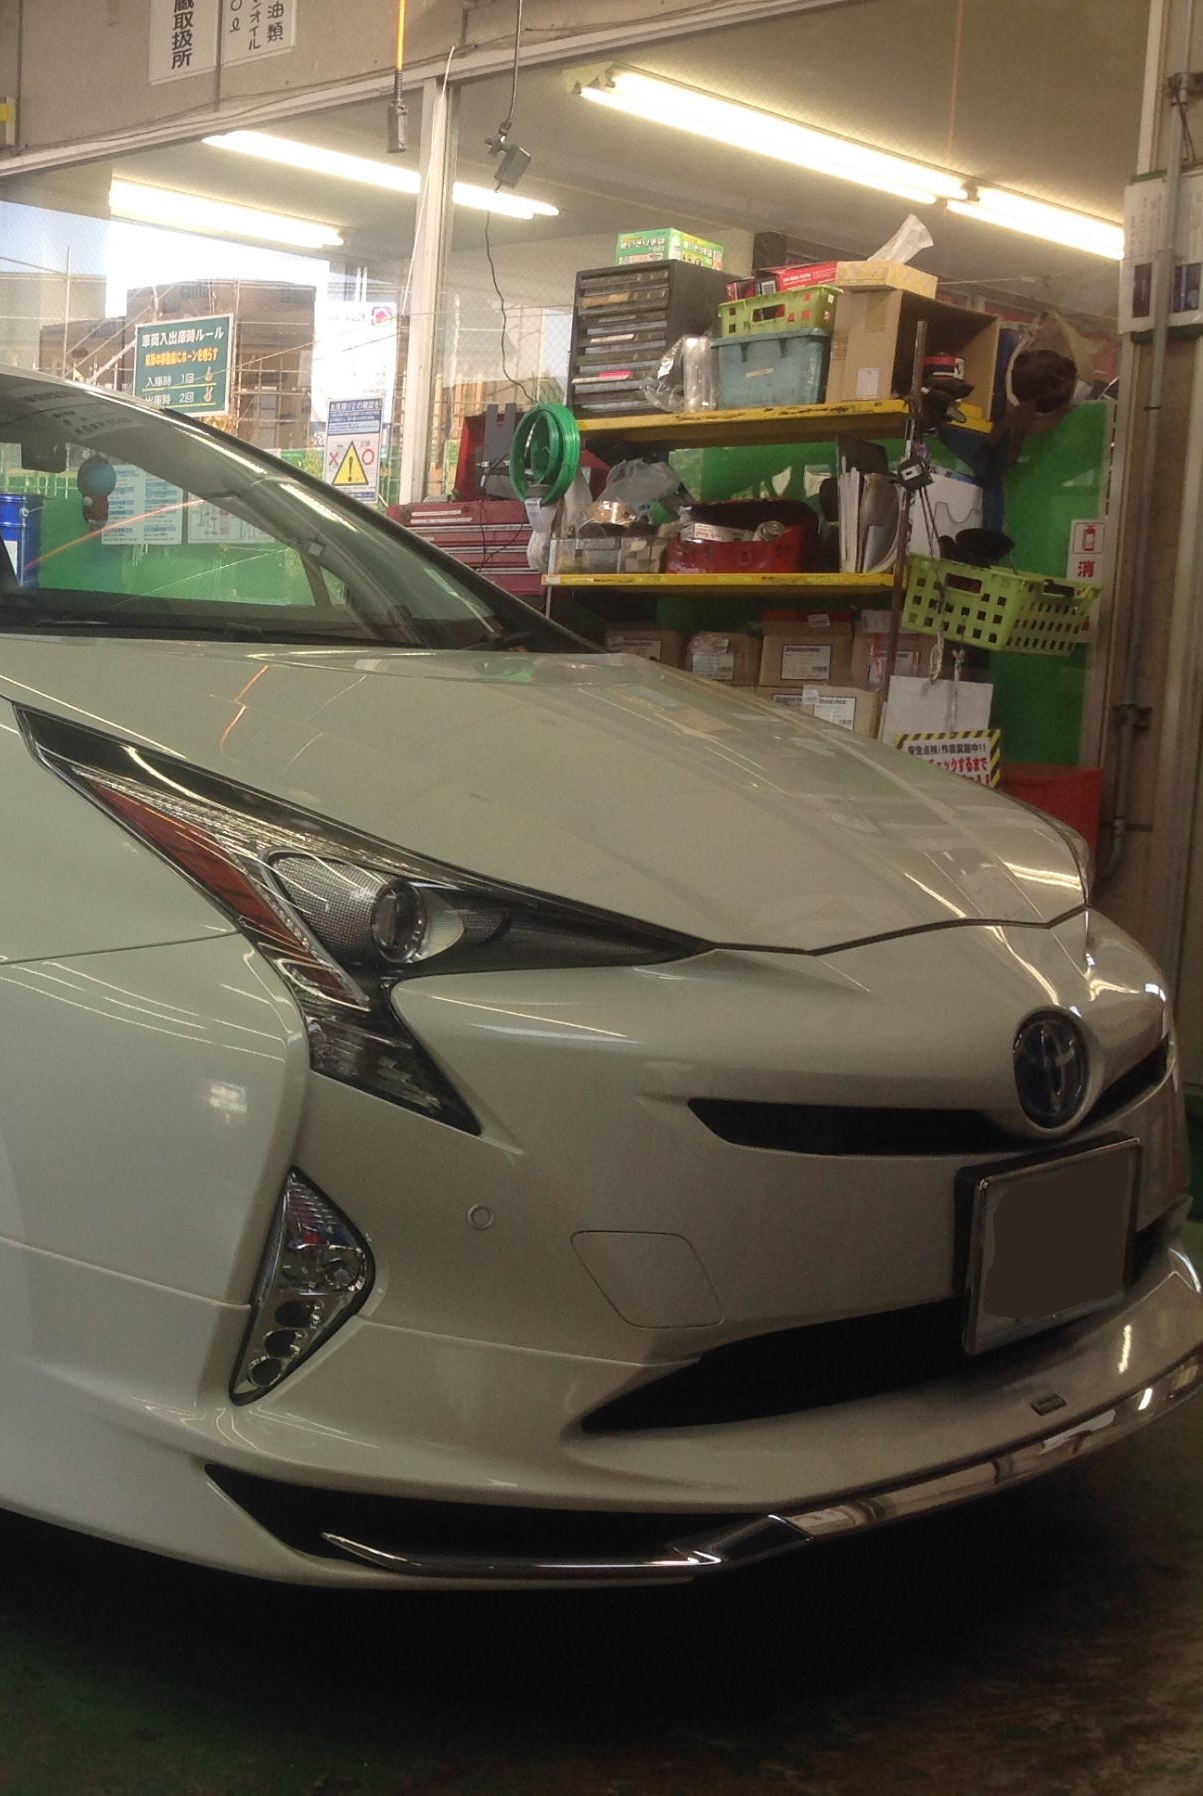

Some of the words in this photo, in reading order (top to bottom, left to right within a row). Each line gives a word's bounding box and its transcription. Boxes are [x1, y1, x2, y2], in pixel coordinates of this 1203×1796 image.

[141, 326, 224, 347] 車両入出庫時ルール
[145, 375, 172, 388] 入庫時
[179, 391, 195, 403] 2回
